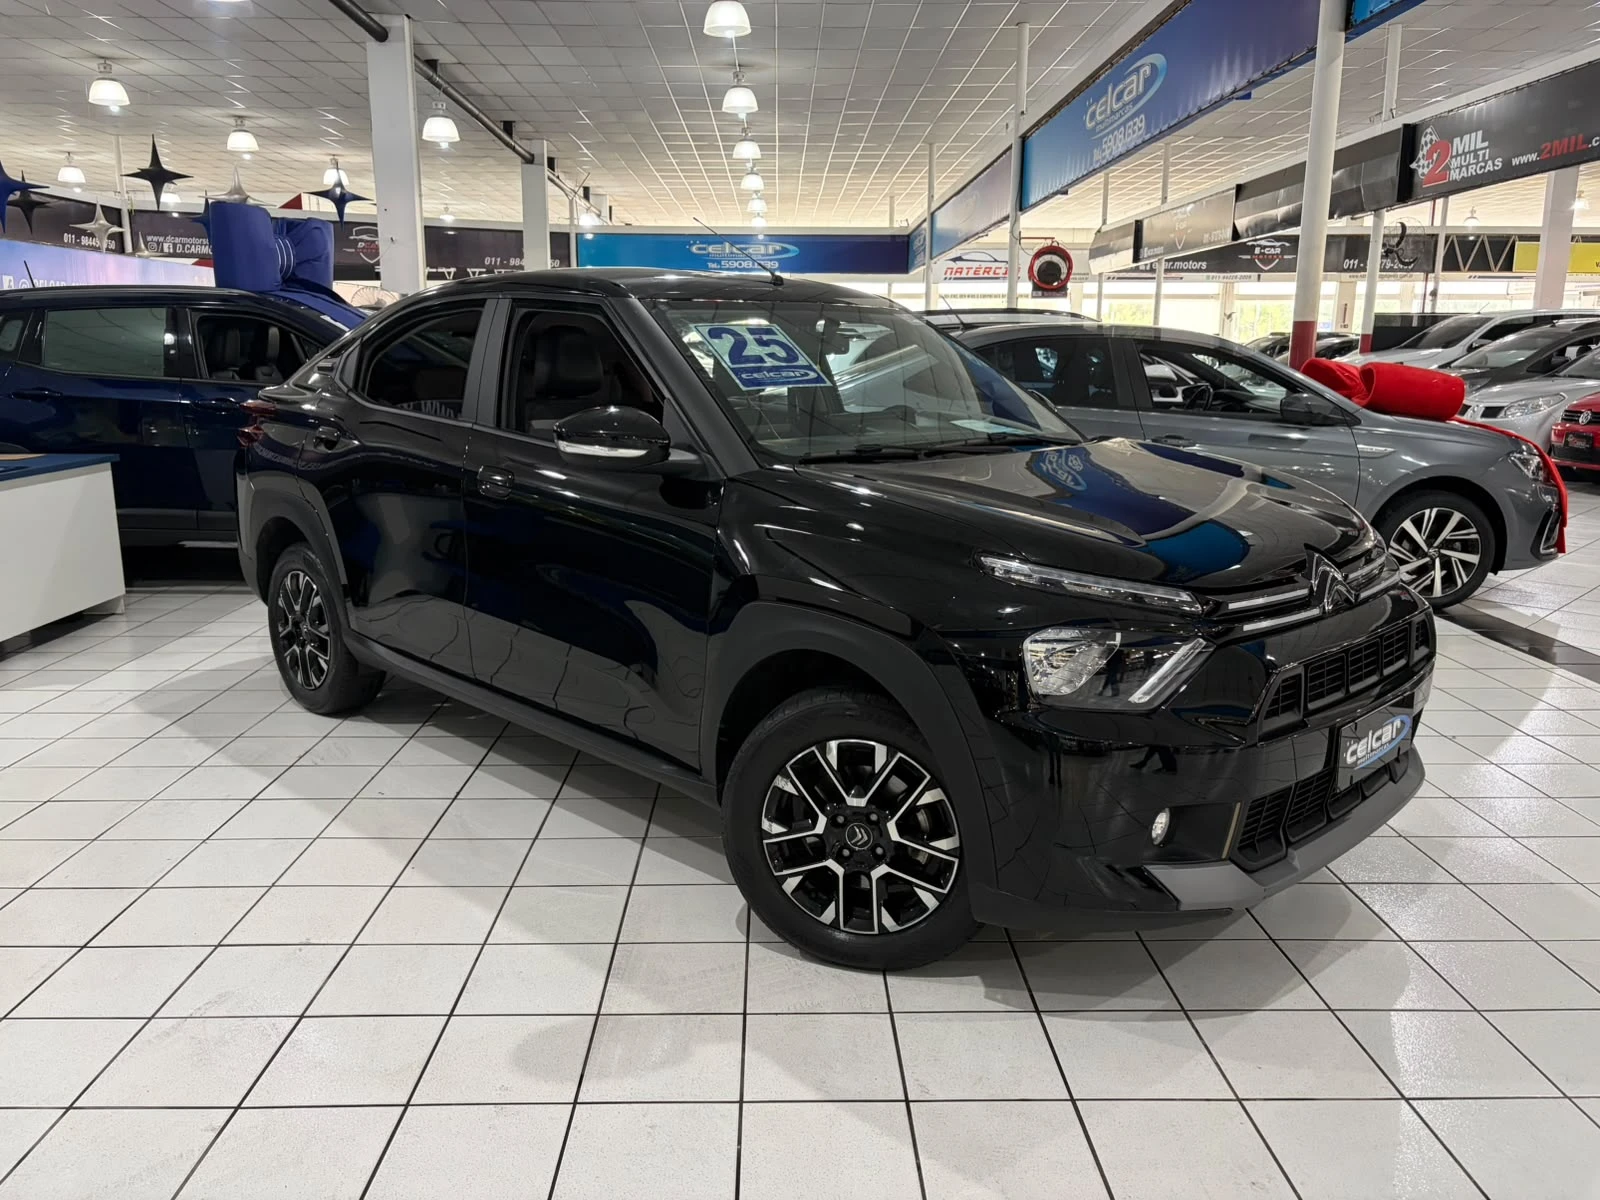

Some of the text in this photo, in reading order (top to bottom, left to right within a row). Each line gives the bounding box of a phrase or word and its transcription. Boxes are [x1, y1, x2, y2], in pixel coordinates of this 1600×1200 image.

[1086, 63, 1152, 129] celcar
[1451, 129, 1490, 157] MIL
[1450, 148, 1490, 170] MULTI
[1449, 157, 1504, 182] MARCAS
[63, 232, 76, 245] 011
[689, 241, 783, 255] celcar
[484, 256, 501, 266] 011
[943, 264, 1022, 276] NATÉRCI
[1343, 258, 1359, 270] 011
[707, 326, 800, 365] 25
[740, 370, 807, 379] celcar
[1346, 718, 1401, 765] celcar
